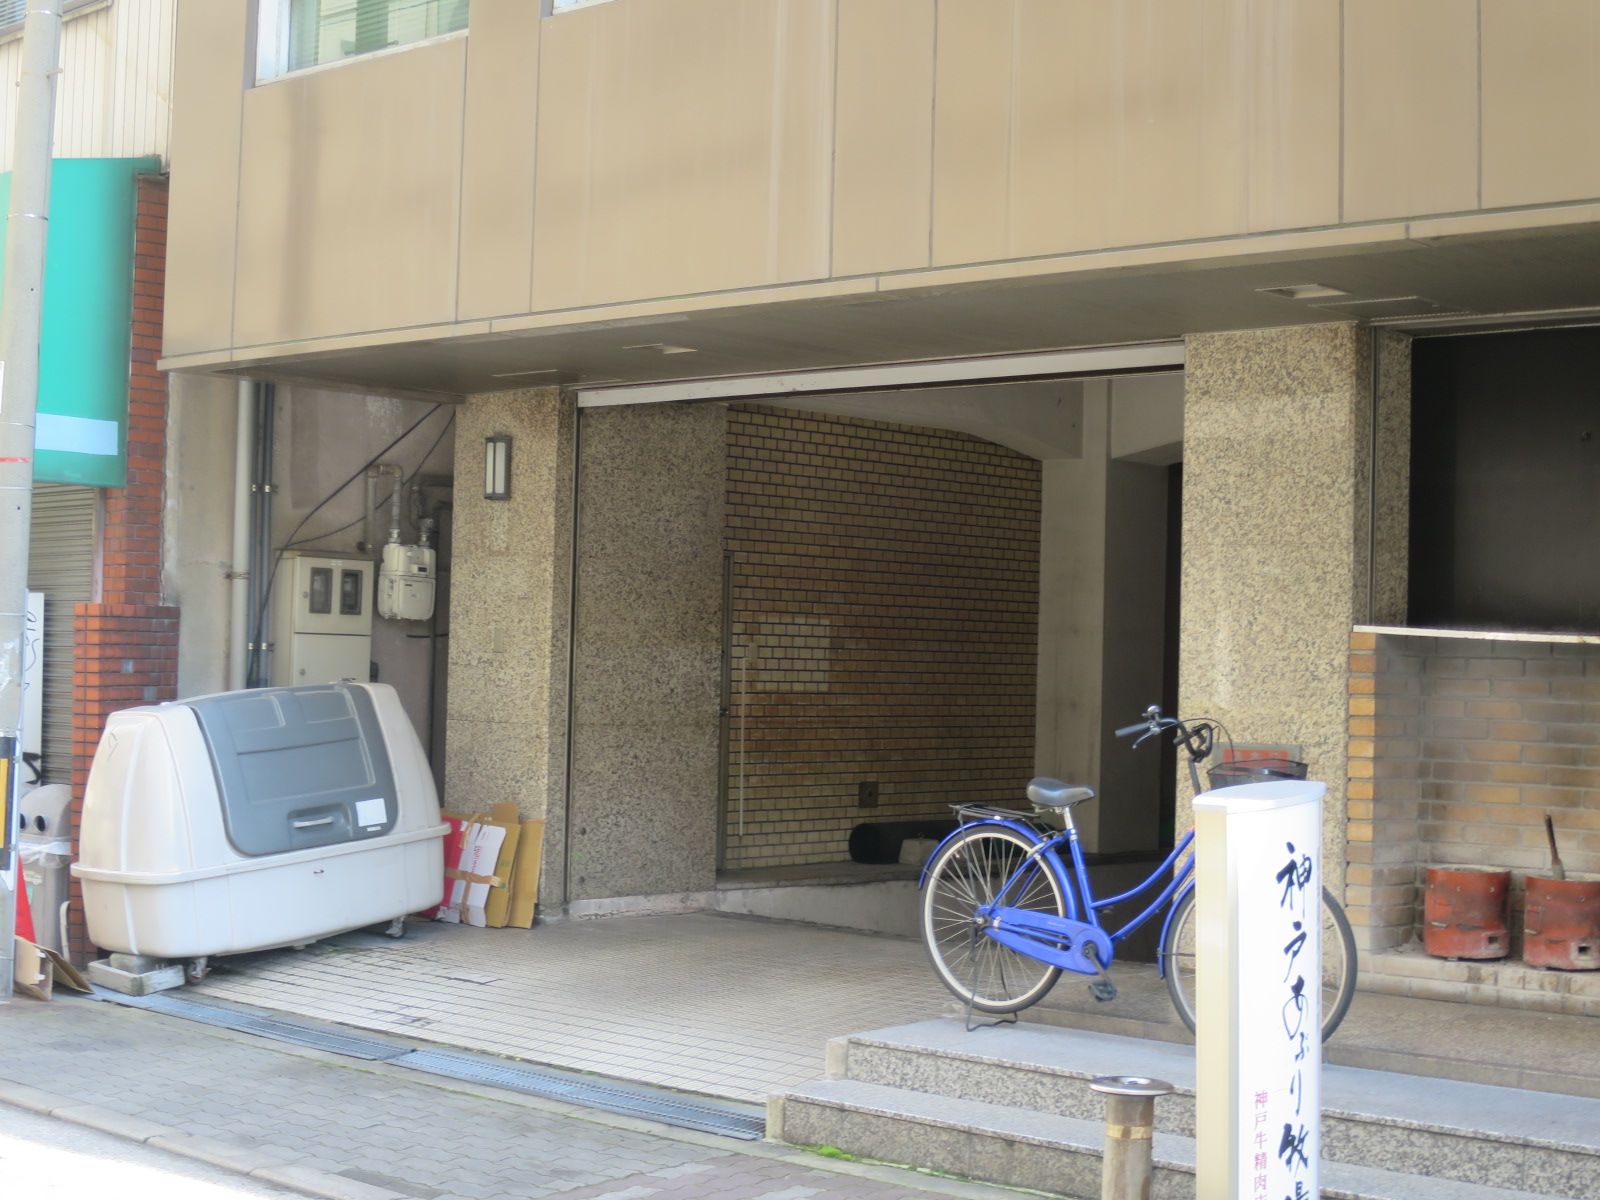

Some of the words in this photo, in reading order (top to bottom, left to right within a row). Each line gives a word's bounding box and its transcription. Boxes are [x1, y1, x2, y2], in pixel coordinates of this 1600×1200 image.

[1254, 1089, 1268, 1200] 神戸牛精肉
